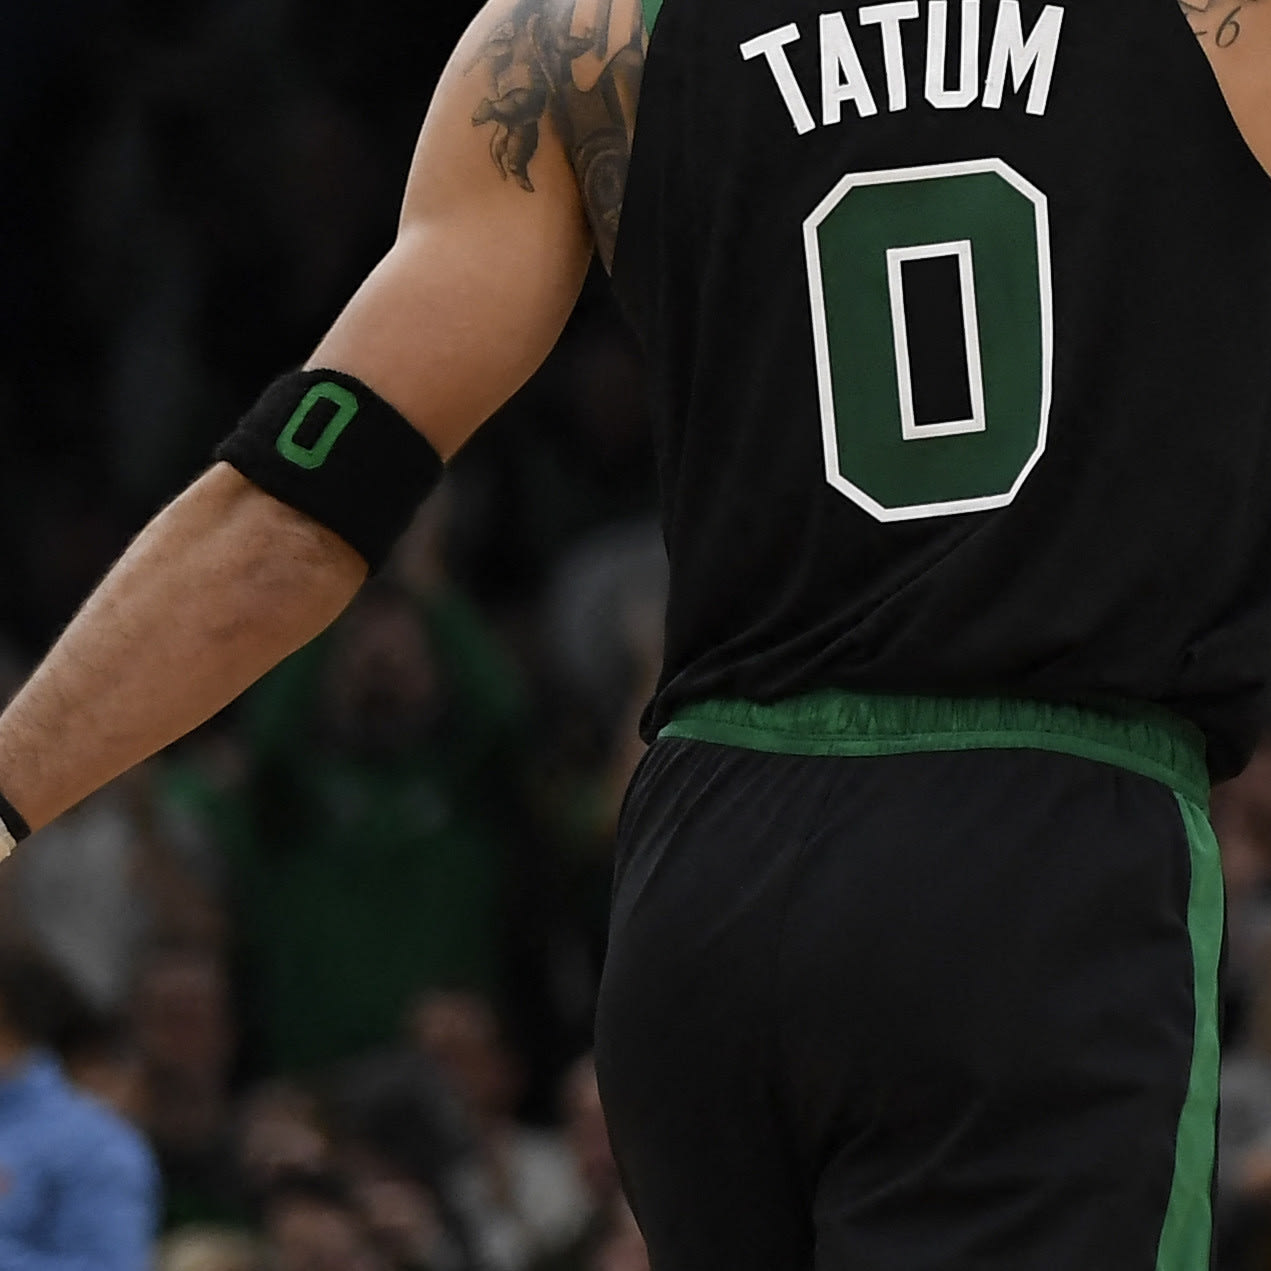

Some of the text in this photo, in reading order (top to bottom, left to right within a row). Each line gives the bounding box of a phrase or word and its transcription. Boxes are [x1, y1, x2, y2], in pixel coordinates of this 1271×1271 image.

[740, 0, 1064, 135] TATUM
[803, 158, 1053, 522] 0
[276, 381, 359, 469] 0
